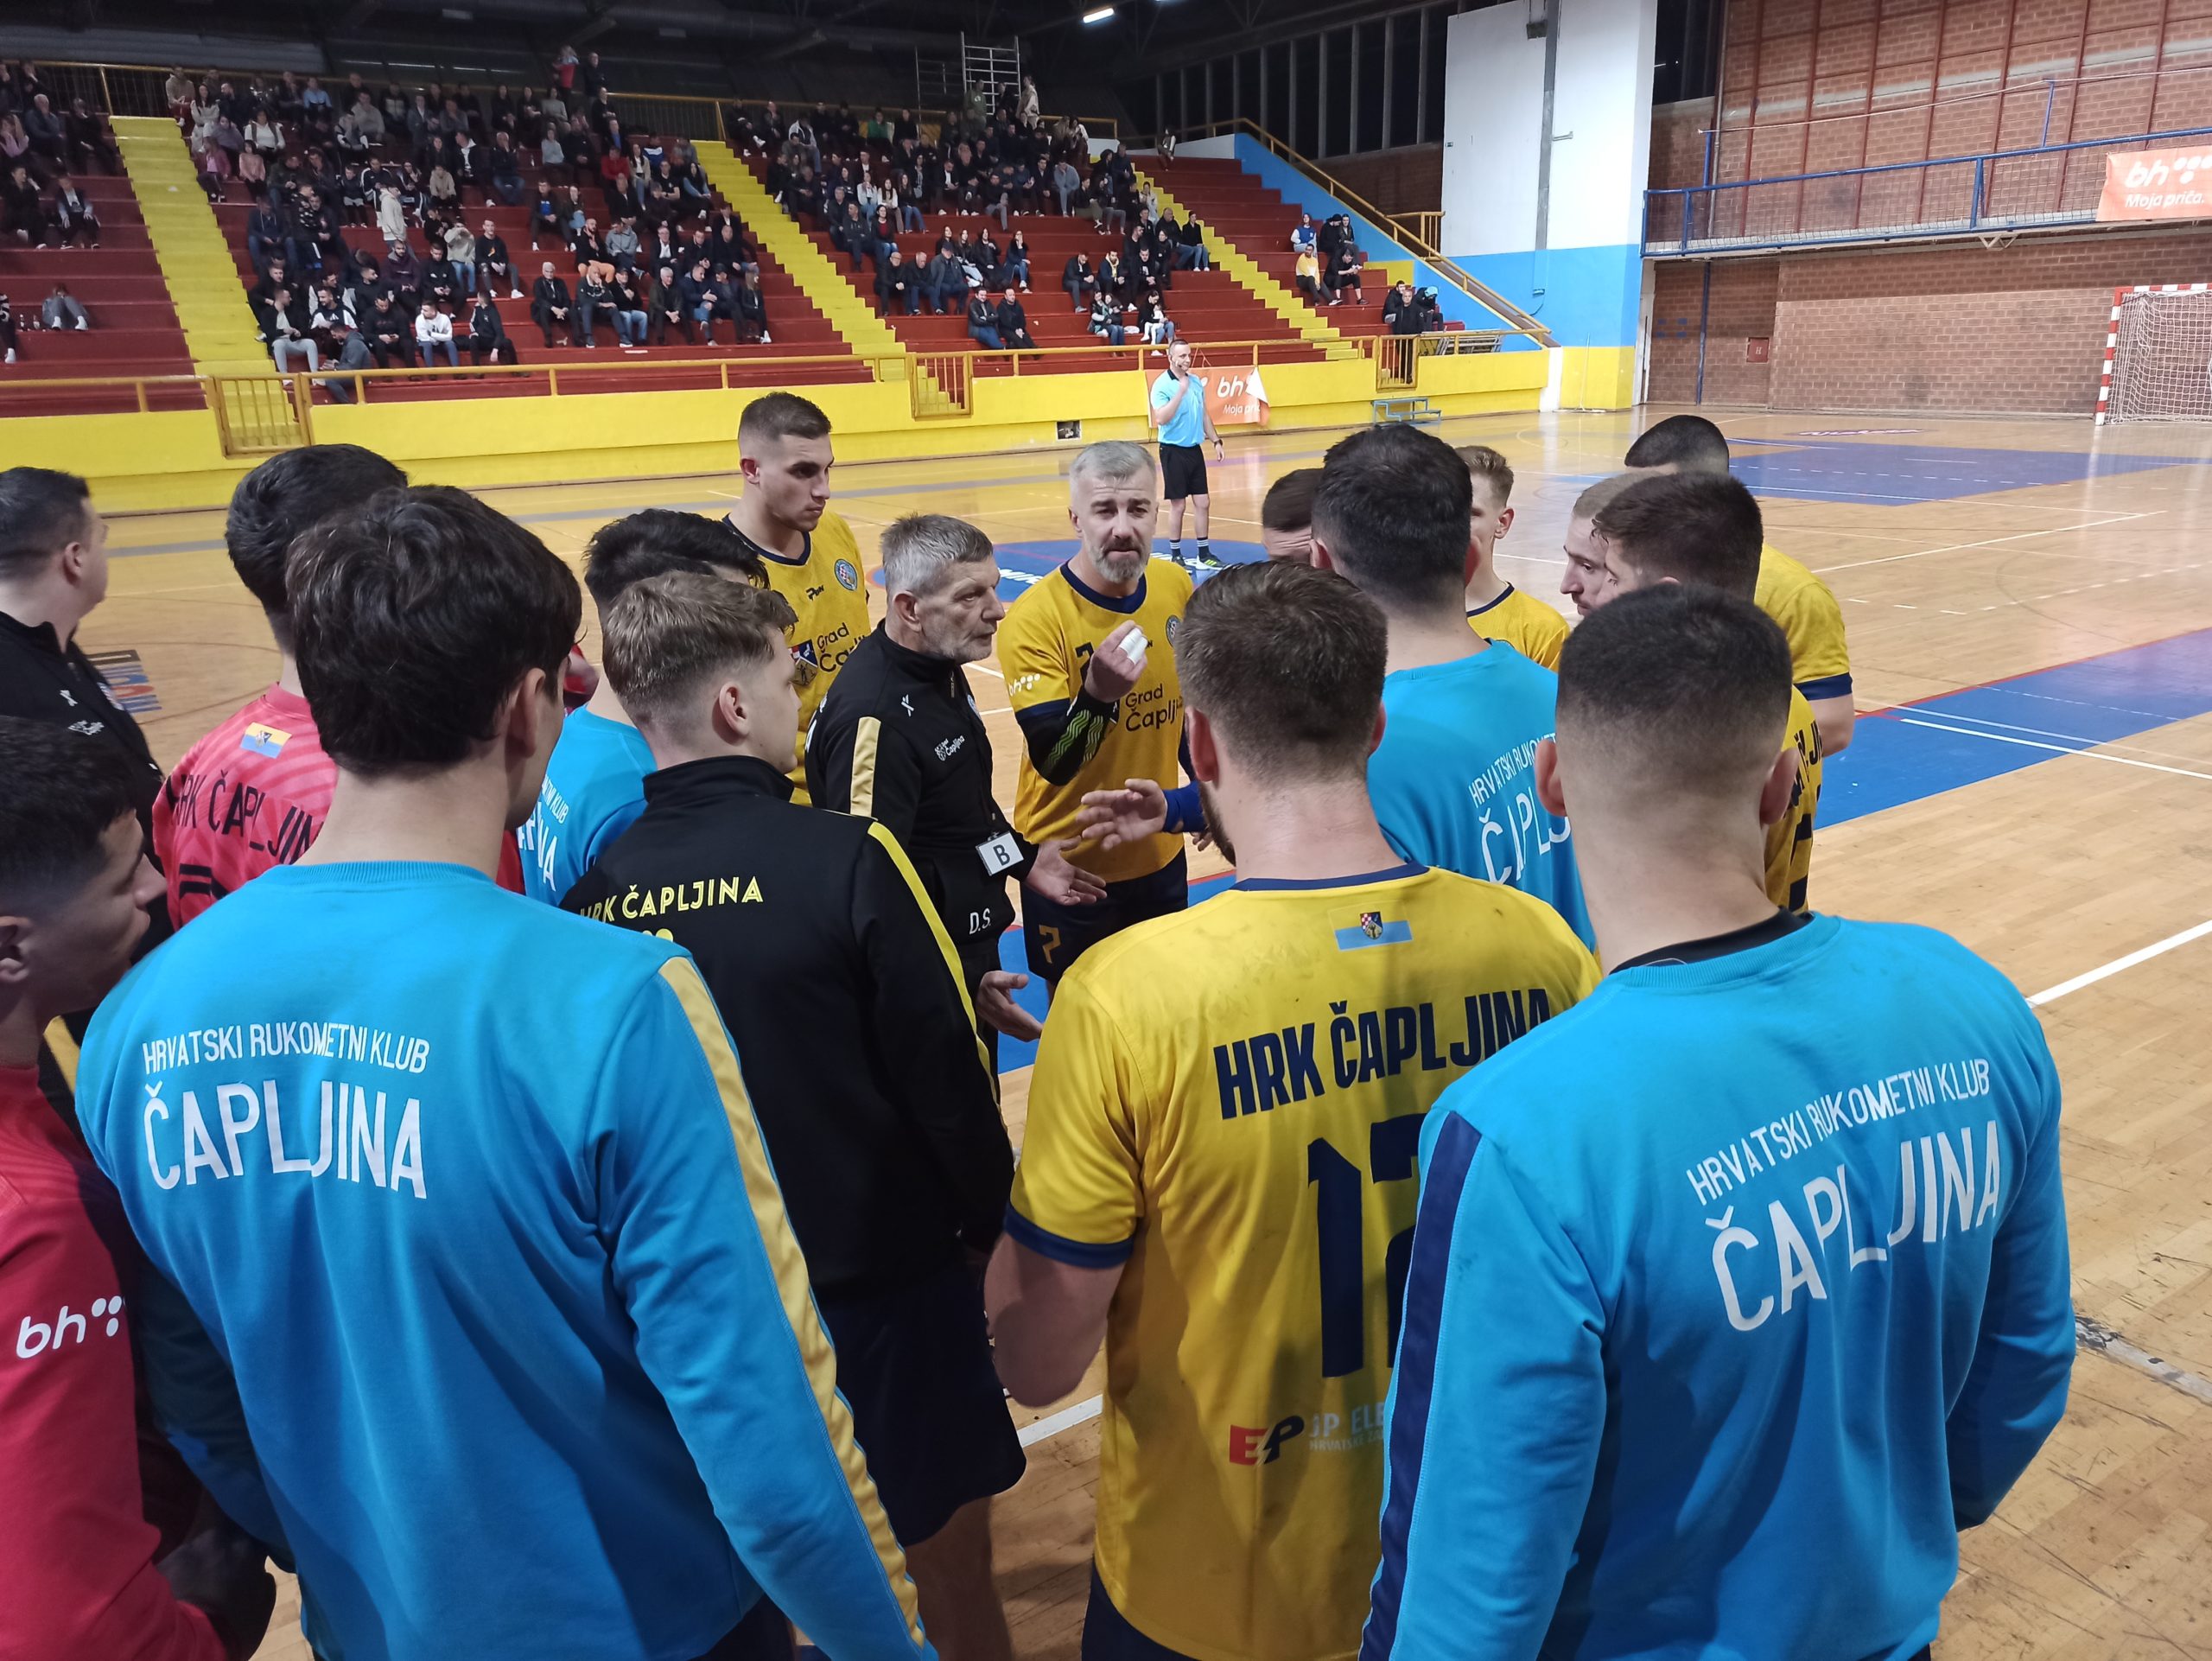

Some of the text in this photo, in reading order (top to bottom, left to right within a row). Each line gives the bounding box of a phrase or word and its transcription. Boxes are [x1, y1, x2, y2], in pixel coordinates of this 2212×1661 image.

[2125, 159, 2169, 188] bh
[2125, 193, 2164, 209] Moja
[1217, 374, 1243, 398] bh
[1223, 404, 1244, 417] Moja
[817, 622, 849, 649] Grad
[1125, 683, 1163, 708] Grad
[1468, 751, 1517, 809] HRVATSKI
[548, 792, 569, 824] KLUB
[993, 843, 1011, 867] B
[621, 875, 764, 920] ČAPLJINA
[143, 1021, 430, 1075] HRVATSKI RUKOMETNI KLUB
[1213, 1022, 1325, 1121] HRK
[143, 1079, 427, 1200] ČAPLJINA
[1686, 1057, 1990, 1206] HRVATSKI RUKOMETNI KLUB
[1705, 1119, 2000, 1332] ČAPLJINA
[16, 1305, 87, 1359] bh
[1229, 1415, 1305, 1466] EP
[1309, 1412, 1340, 1438] JP
